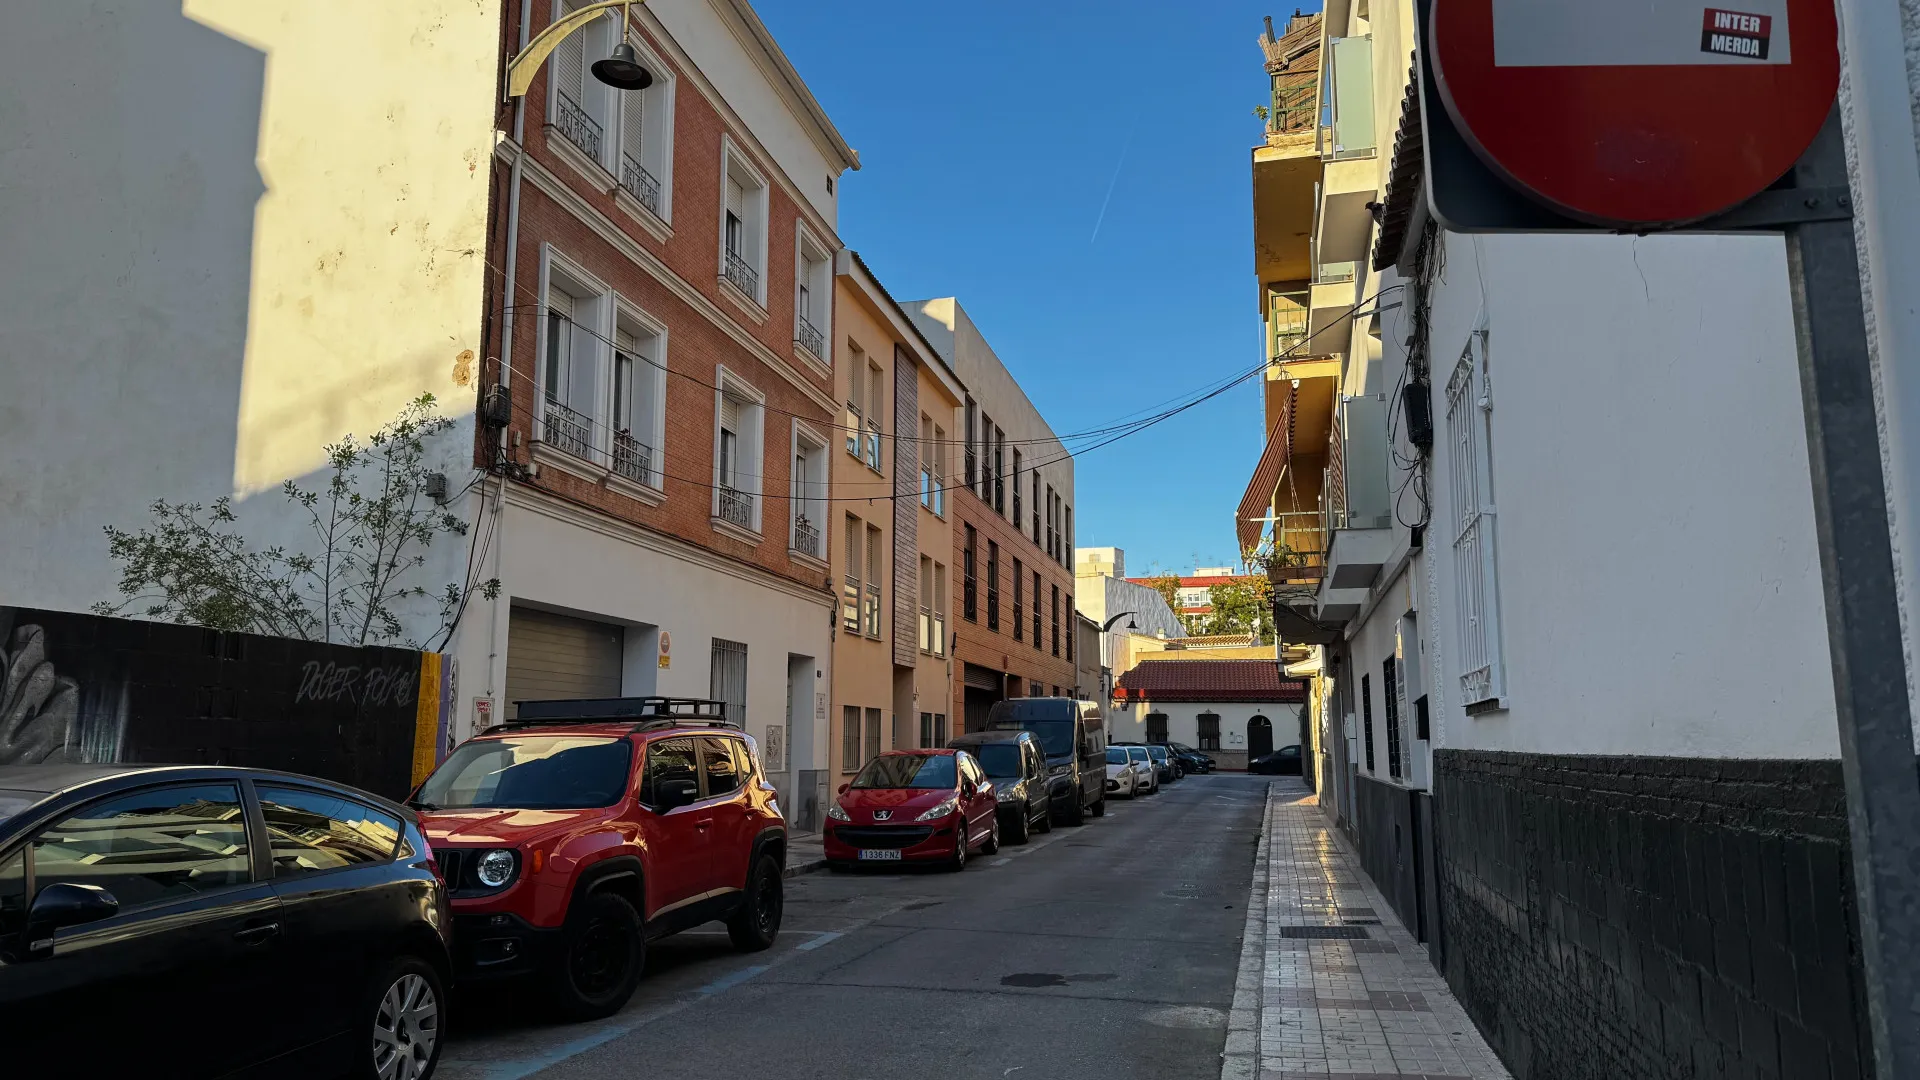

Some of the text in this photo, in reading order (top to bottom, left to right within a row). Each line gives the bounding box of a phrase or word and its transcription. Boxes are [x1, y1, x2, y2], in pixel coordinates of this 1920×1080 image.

[1714, 12, 1761, 33] INTER
[1711, 33, 1759, 56] MERDA
[865, 850, 883, 859] 1336
